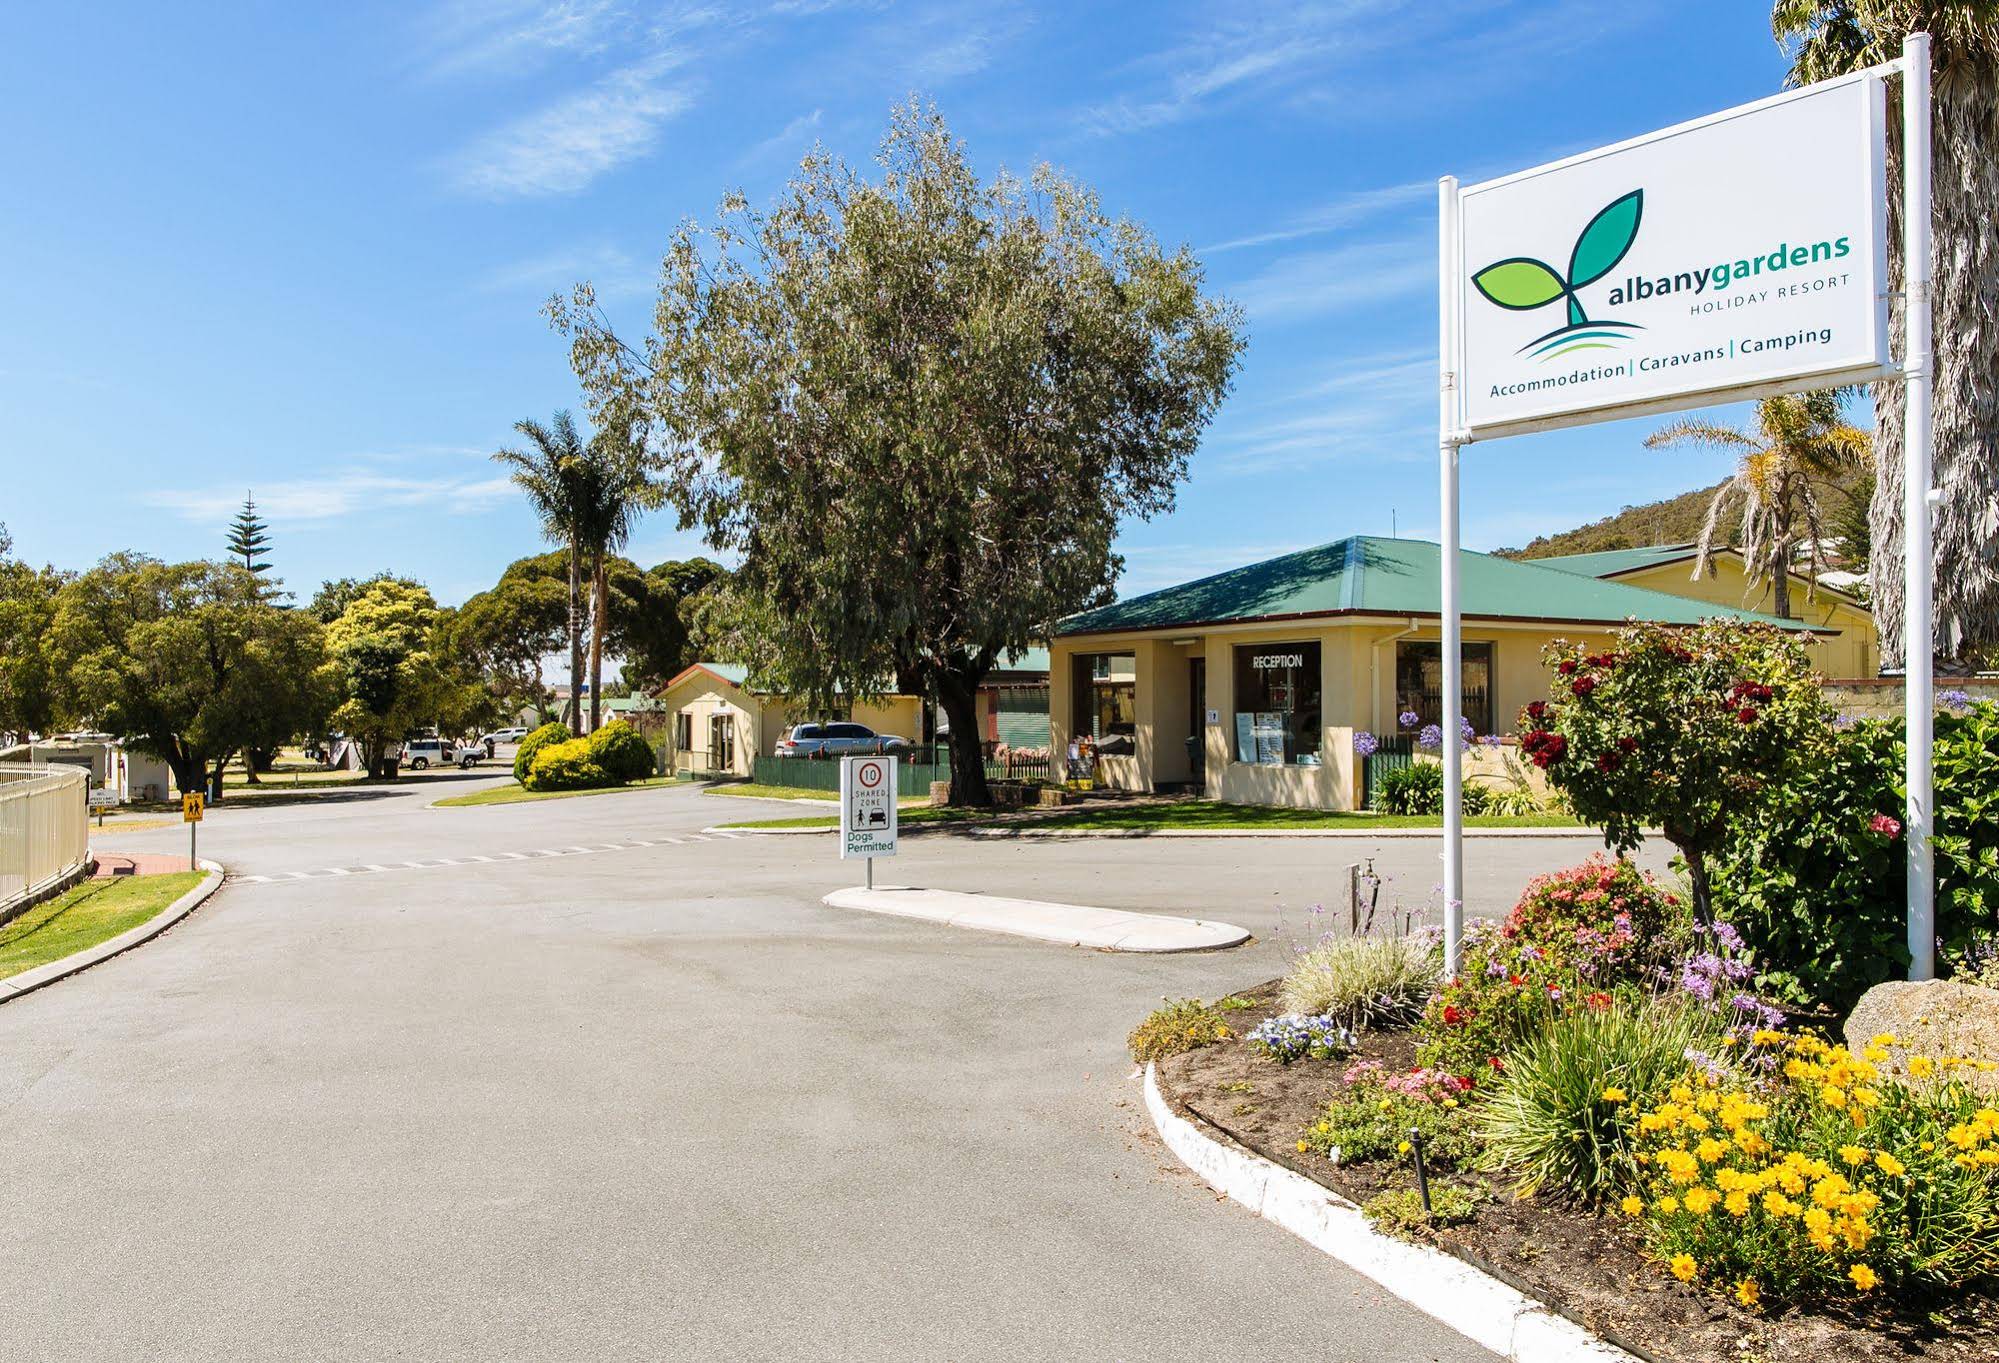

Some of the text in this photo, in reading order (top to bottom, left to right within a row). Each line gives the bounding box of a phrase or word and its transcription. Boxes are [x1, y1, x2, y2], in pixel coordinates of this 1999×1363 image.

[1690, 274, 1849, 315] HOLIDAY RESORT
[1490, 328, 1831, 398] Accommodation Caravans Camping
[1253, 654, 1302, 668] RECEPTION
[864, 769, 876, 781] 10
[847, 832, 873, 842] Dogs
[847, 841, 894, 852] Permitted
